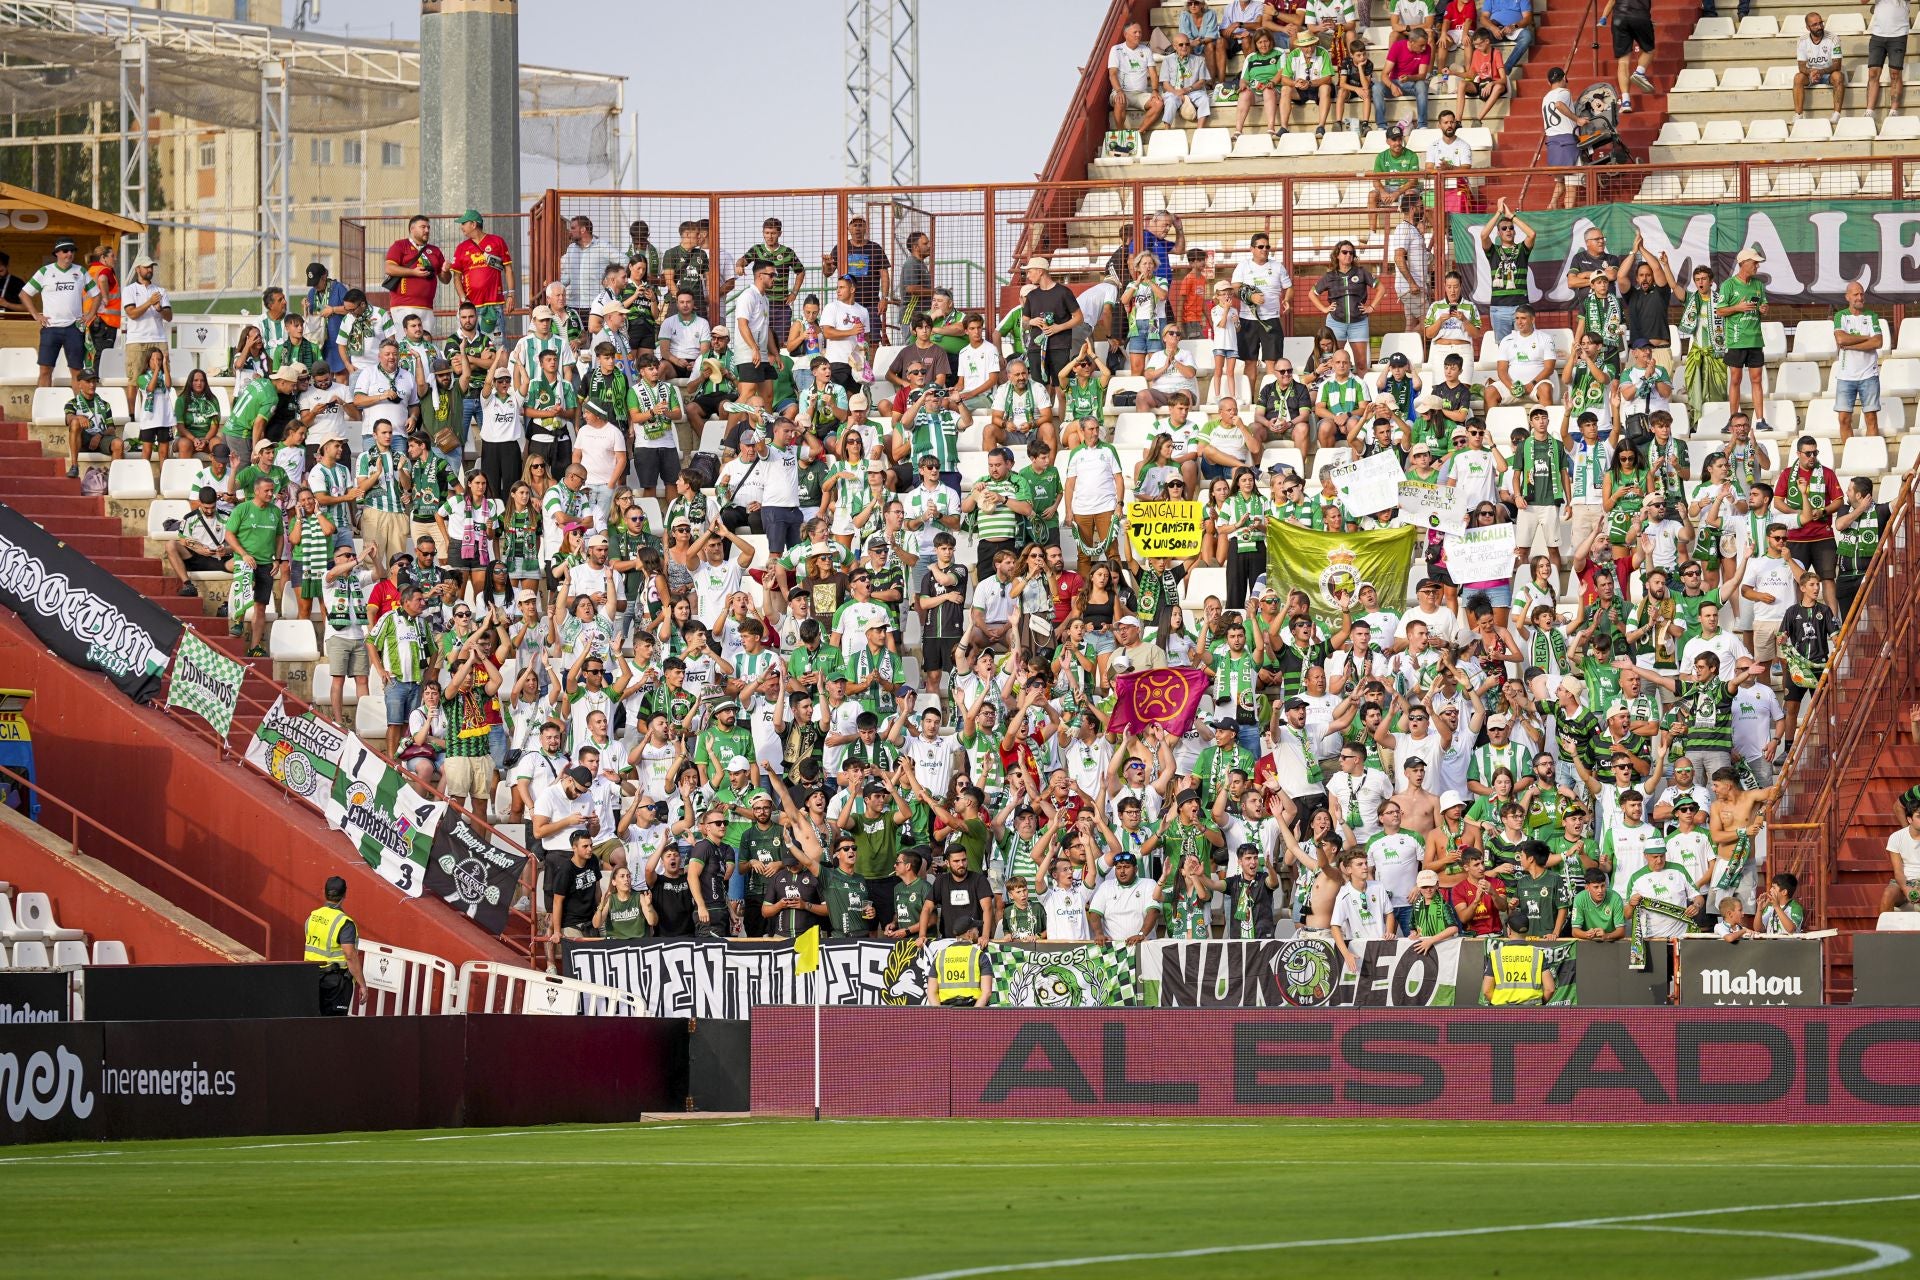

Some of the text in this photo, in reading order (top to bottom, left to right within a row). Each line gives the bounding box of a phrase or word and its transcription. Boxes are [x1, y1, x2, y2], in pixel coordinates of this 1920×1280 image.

[1543, 101, 1562, 130] 18
[0, 209, 48, 231] O
[55, 281, 75, 291] Teka
[11, 394, 30, 404] 278
[49, 434, 66, 445] 276
[123, 508, 146, 518] 270
[1132, 503, 1193, 519] SANGALLI
[1132, 522, 1152, 537] TU
[1141, 538, 1152, 550] X
[1154, 538, 1168, 549] UN
[181, 655, 234, 709] CONCANOS
[686, 670, 707, 683] Teka
[415, 803, 436, 828] 9
[347, 804, 408, 859] CORRALES
[395, 863, 414, 891] 3
[945, 956, 969, 964] SEGURIDAD
[1029, 949, 1088, 966] LOCOS
[1502, 954, 1532, 963] SEGURIDAD
[946, 970, 966, 981] 094
[1506, 970, 1528, 982] 024
[1700, 968, 1804, 996] Mahou
[979, 1022, 1198, 1104] AL
[102, 1059, 236, 1106] inerenergia.es
